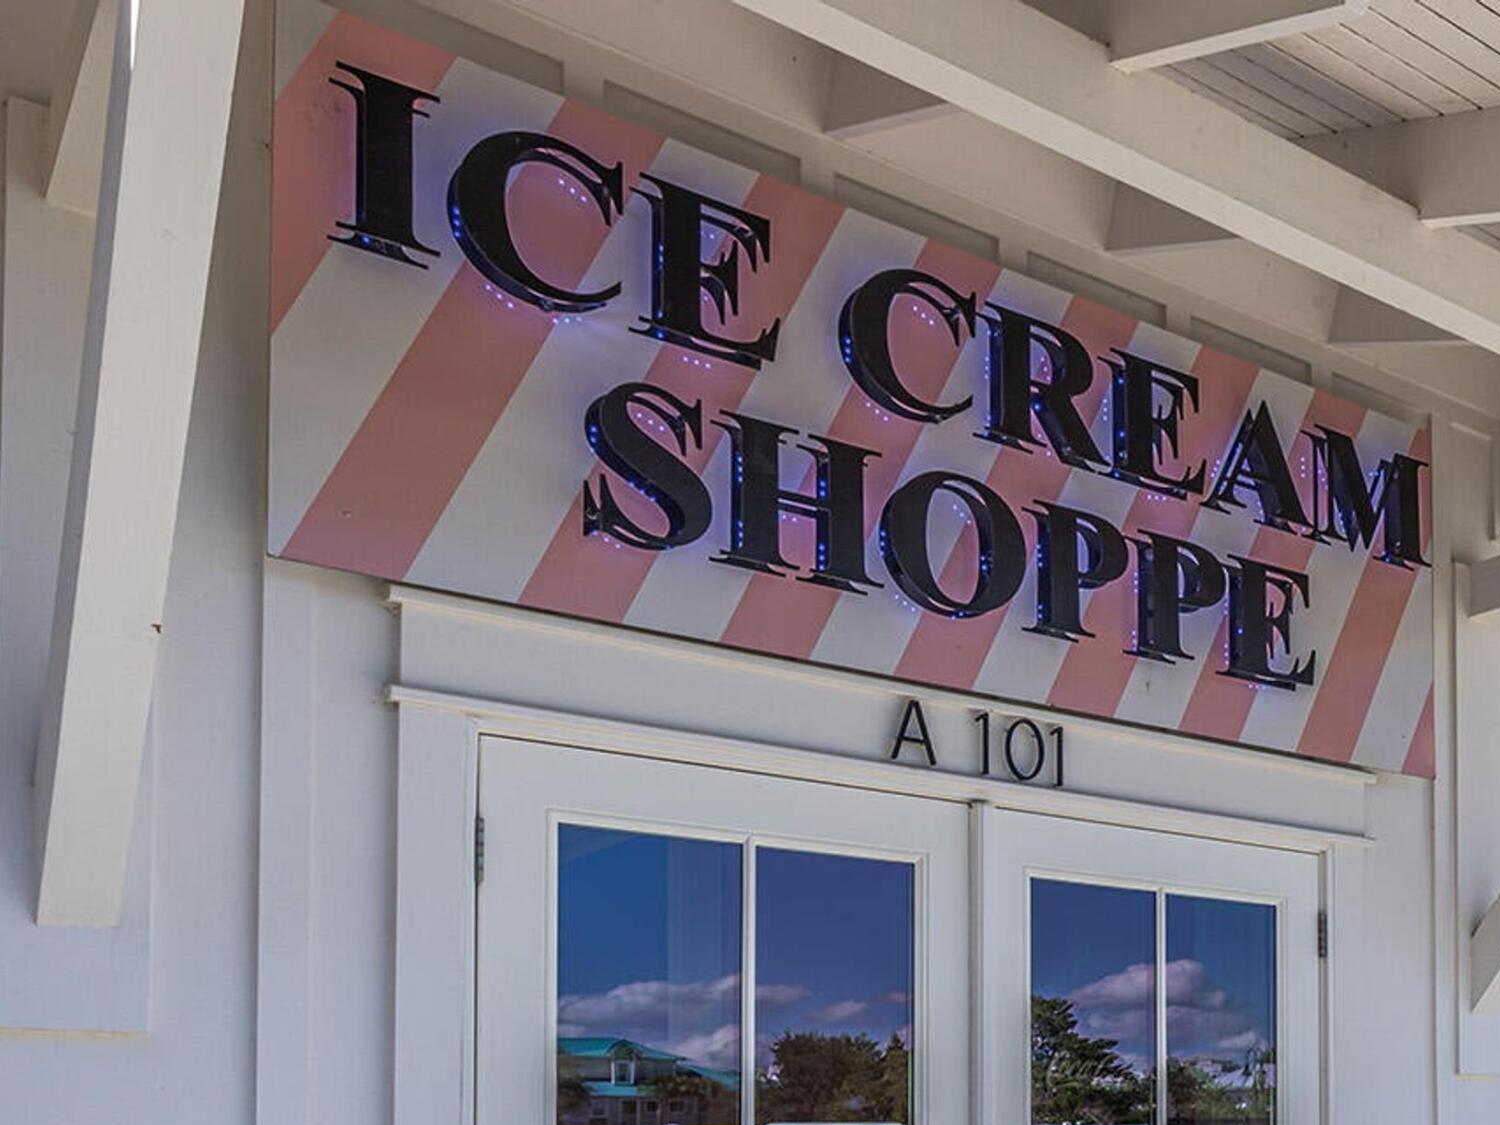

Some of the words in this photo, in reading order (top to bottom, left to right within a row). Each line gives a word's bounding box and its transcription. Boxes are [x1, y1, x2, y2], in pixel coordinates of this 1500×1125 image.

[327, 61, 780, 370] ICE
[838, 268, 1432, 571] CREAM
[583, 382, 1316, 691] SHOPPE
[891, 700, 936, 766] A
[974, 712, 1063, 787] 101
